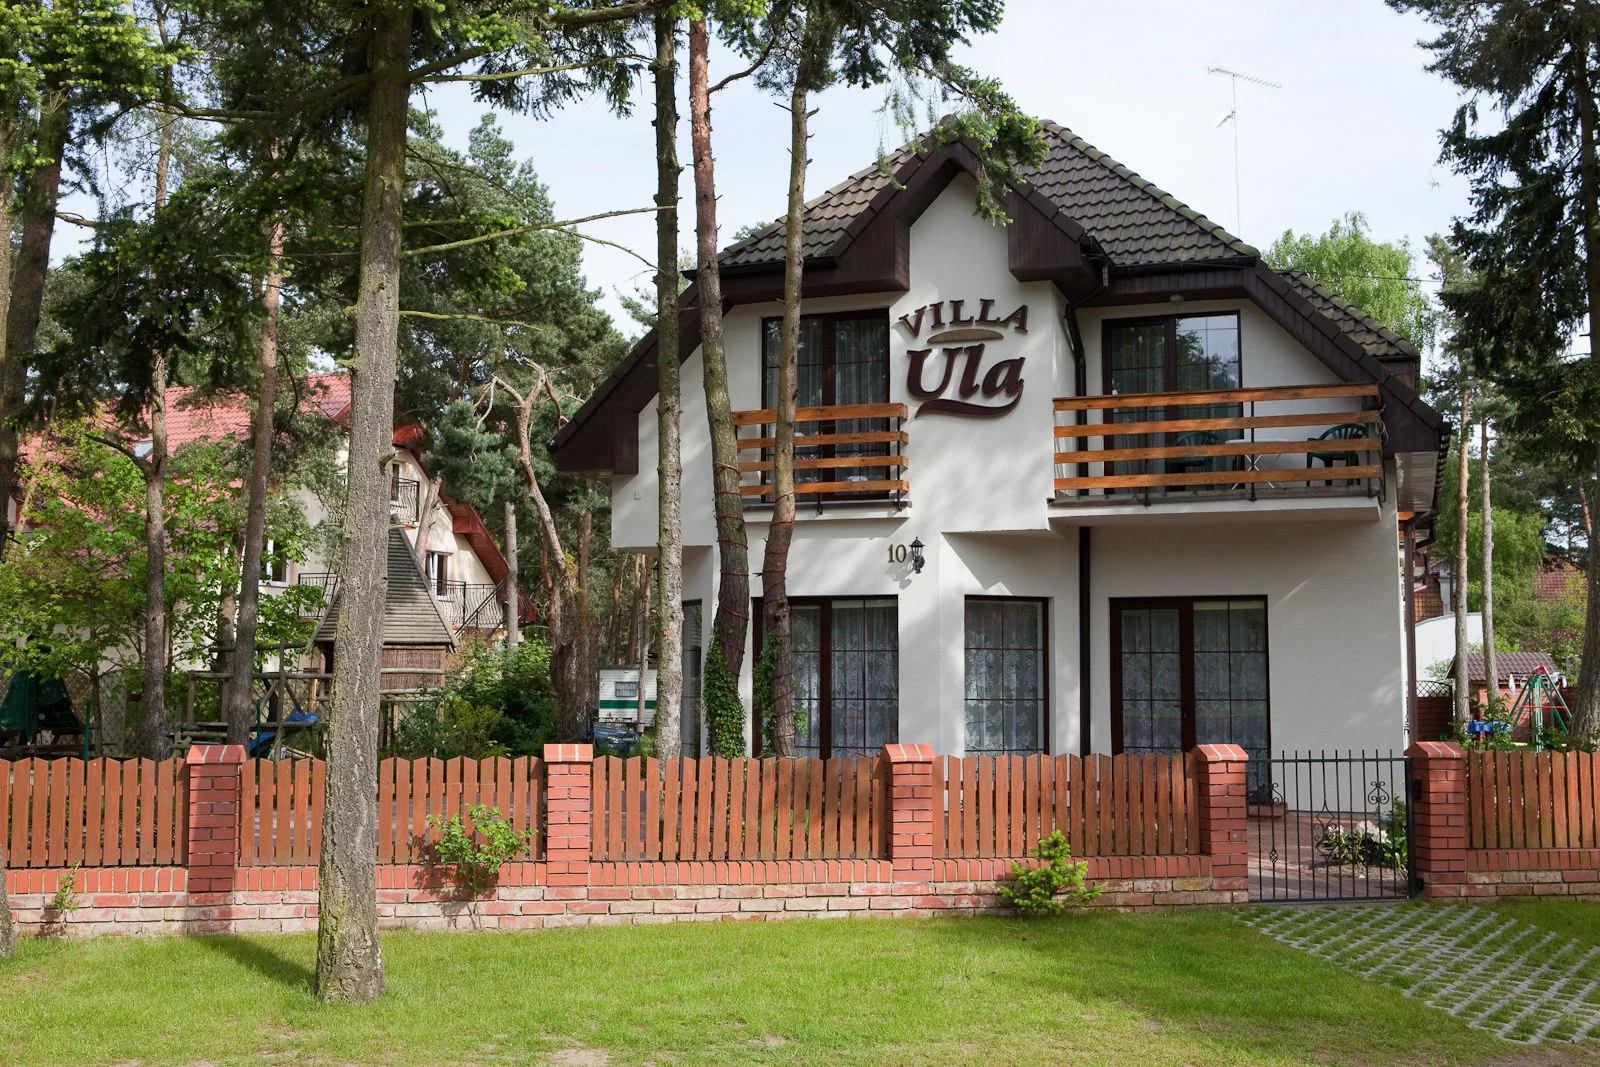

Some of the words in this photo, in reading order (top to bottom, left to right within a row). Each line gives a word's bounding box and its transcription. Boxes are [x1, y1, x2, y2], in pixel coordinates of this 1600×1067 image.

[899, 298, 1028, 337] VILLA
[907, 343, 1025, 418] Ula
[887, 543, 907, 563] 10
